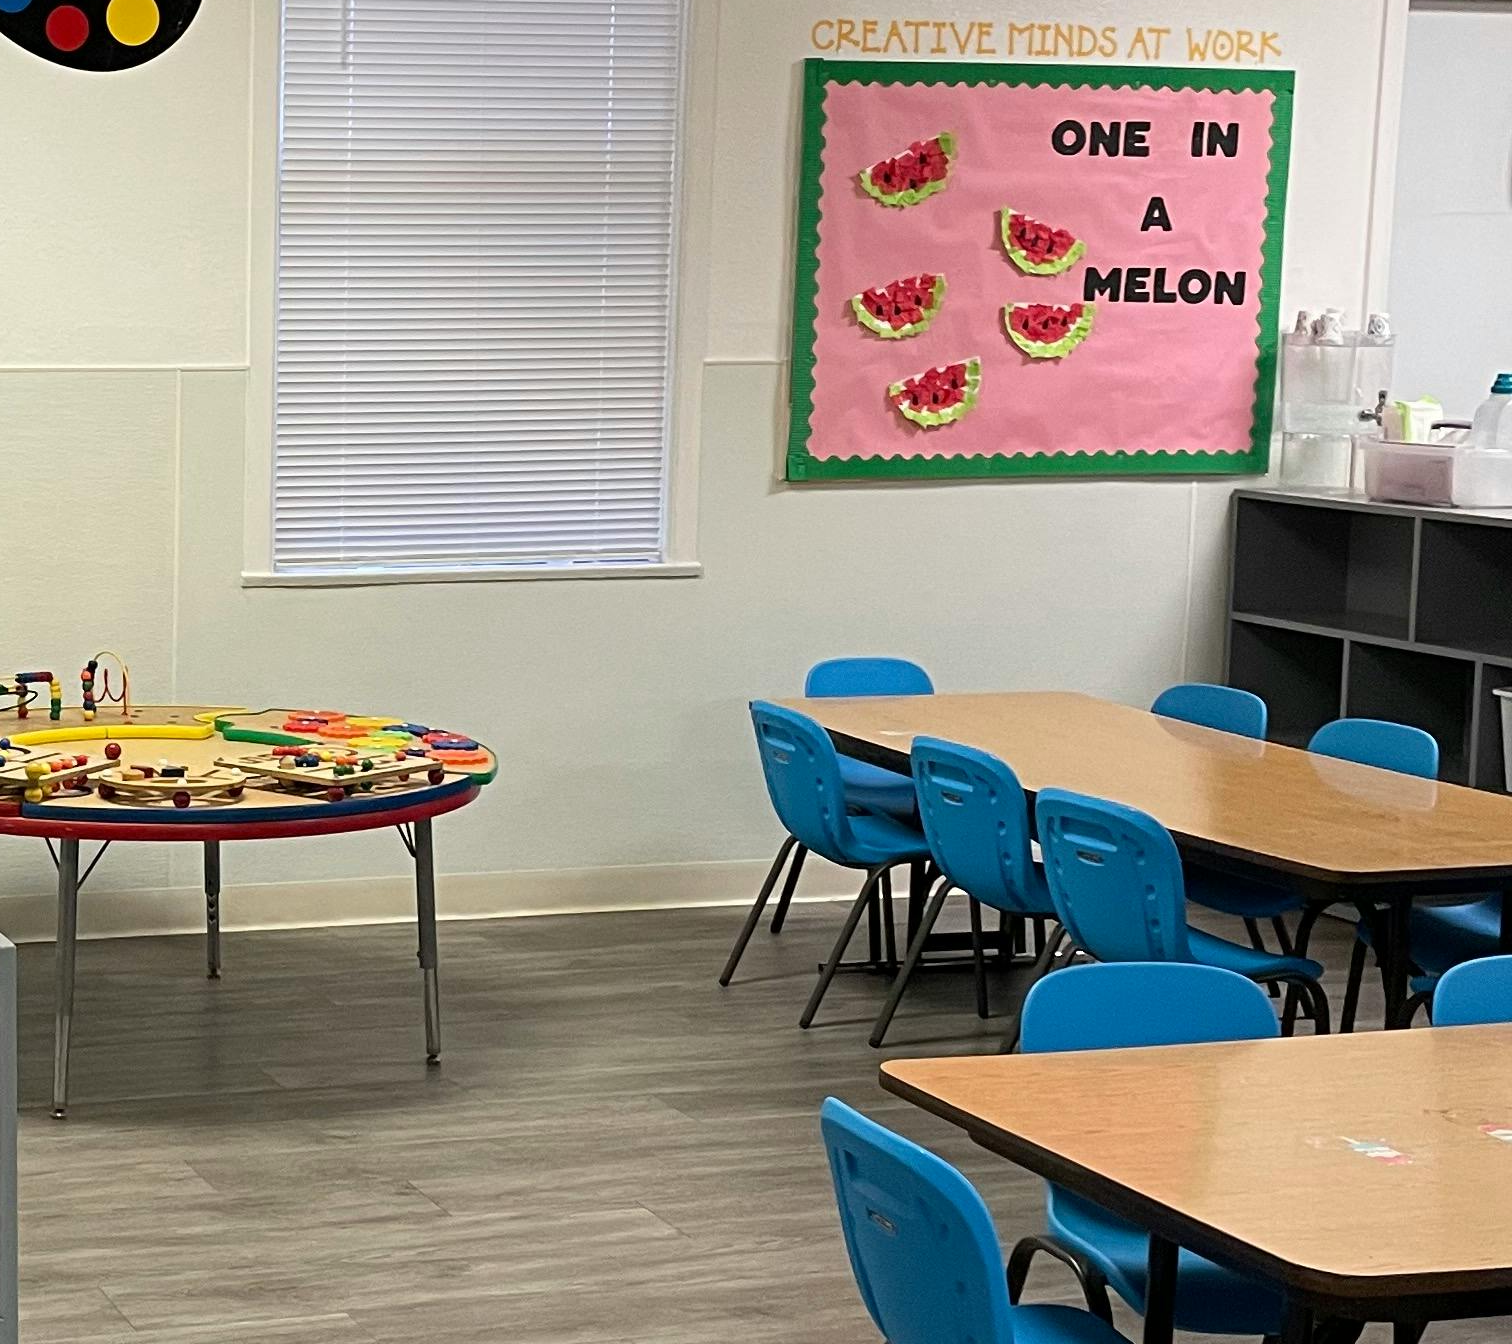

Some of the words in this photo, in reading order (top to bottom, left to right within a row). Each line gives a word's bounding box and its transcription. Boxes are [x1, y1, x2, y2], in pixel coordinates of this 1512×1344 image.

[811, 19, 994, 54] CREATIVE
[1008, 22, 1118, 58] MINDS
[1127, 25, 1171, 59] AT
[1186, 27, 1283, 64] WORK
[1052, 120, 1152, 157] ONE
[1191, 121, 1240, 158] IN
[1140, 196, 1173, 232] A
[1083, 267, 1247, 306] MELON
